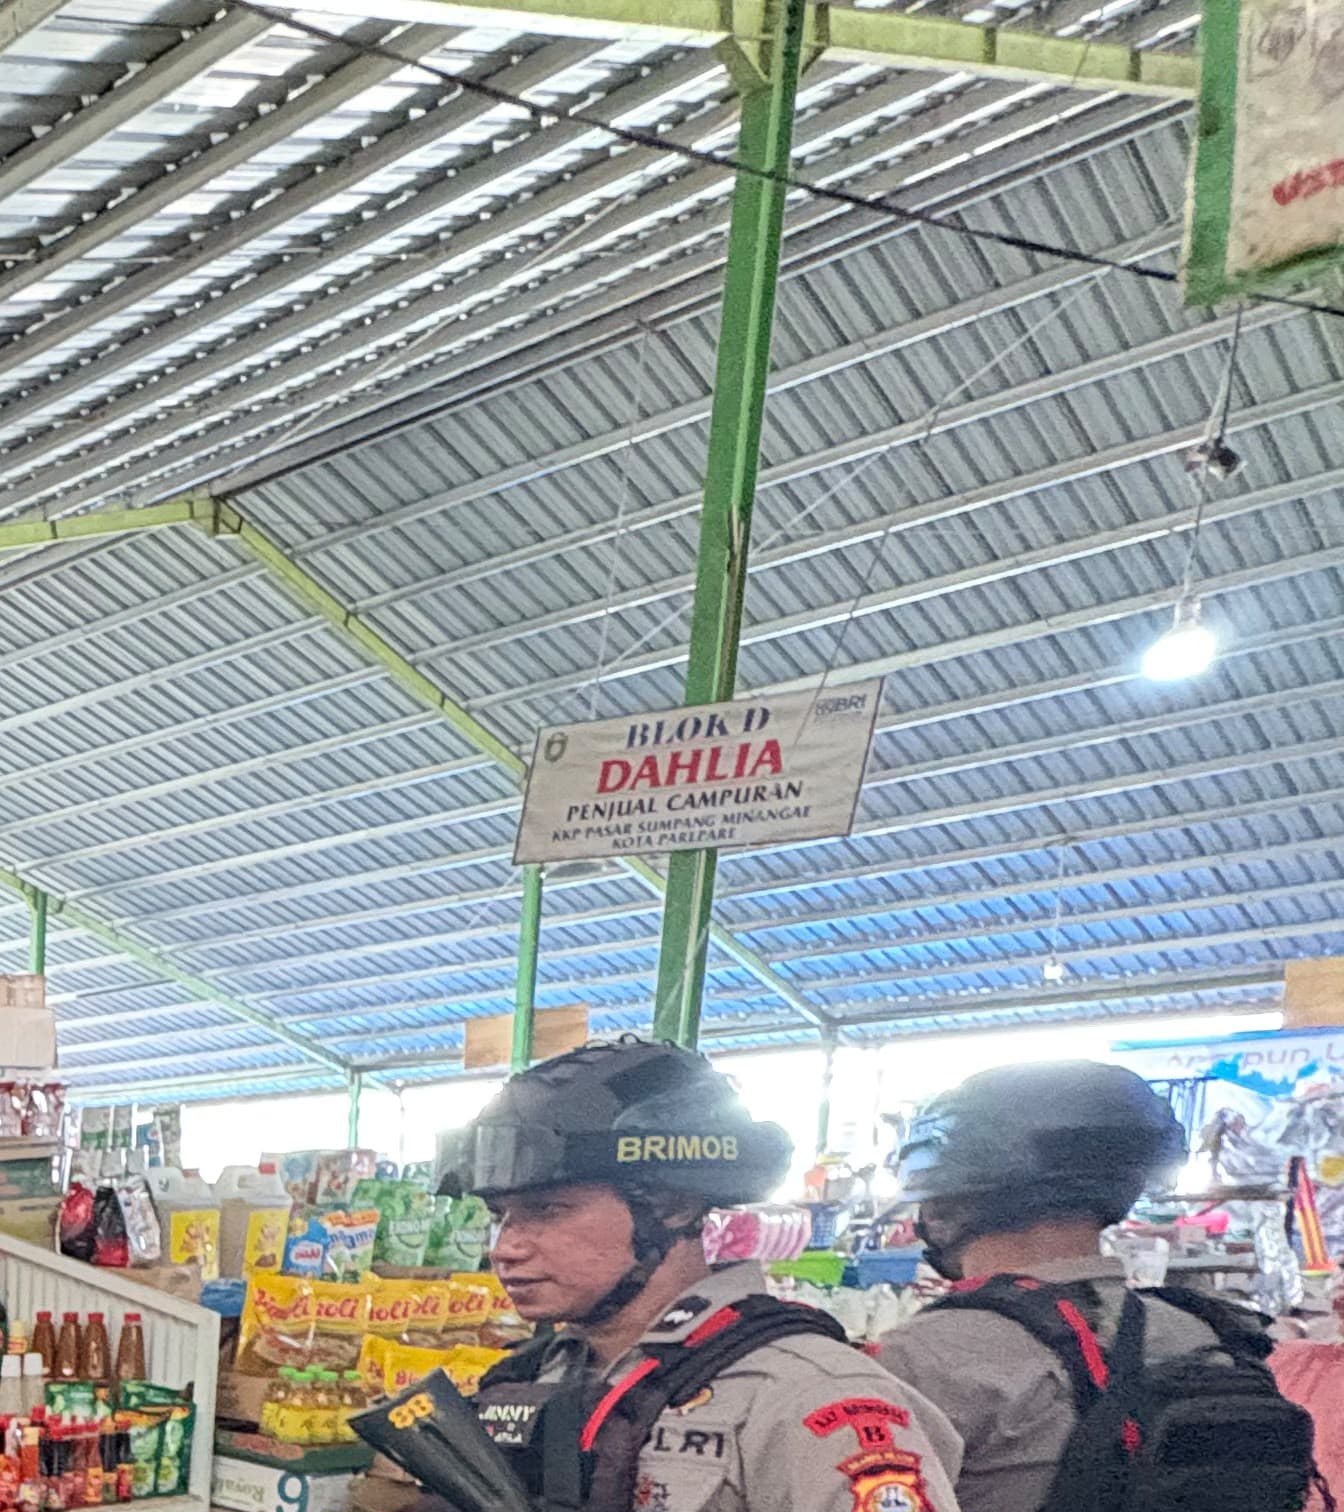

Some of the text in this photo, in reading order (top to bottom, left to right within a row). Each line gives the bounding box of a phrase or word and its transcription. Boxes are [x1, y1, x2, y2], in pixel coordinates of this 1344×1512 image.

[625, 705, 774, 750] BLOK D
[596, 738, 784, 795] DAHLIA
[566, 780, 803, 822] PENJUAL CAMPURAN
[585, 822, 632, 840] PASAR
[637, 814, 716, 834] SUMPANG
[616, 1136, 739, 1163] BRIMOB
